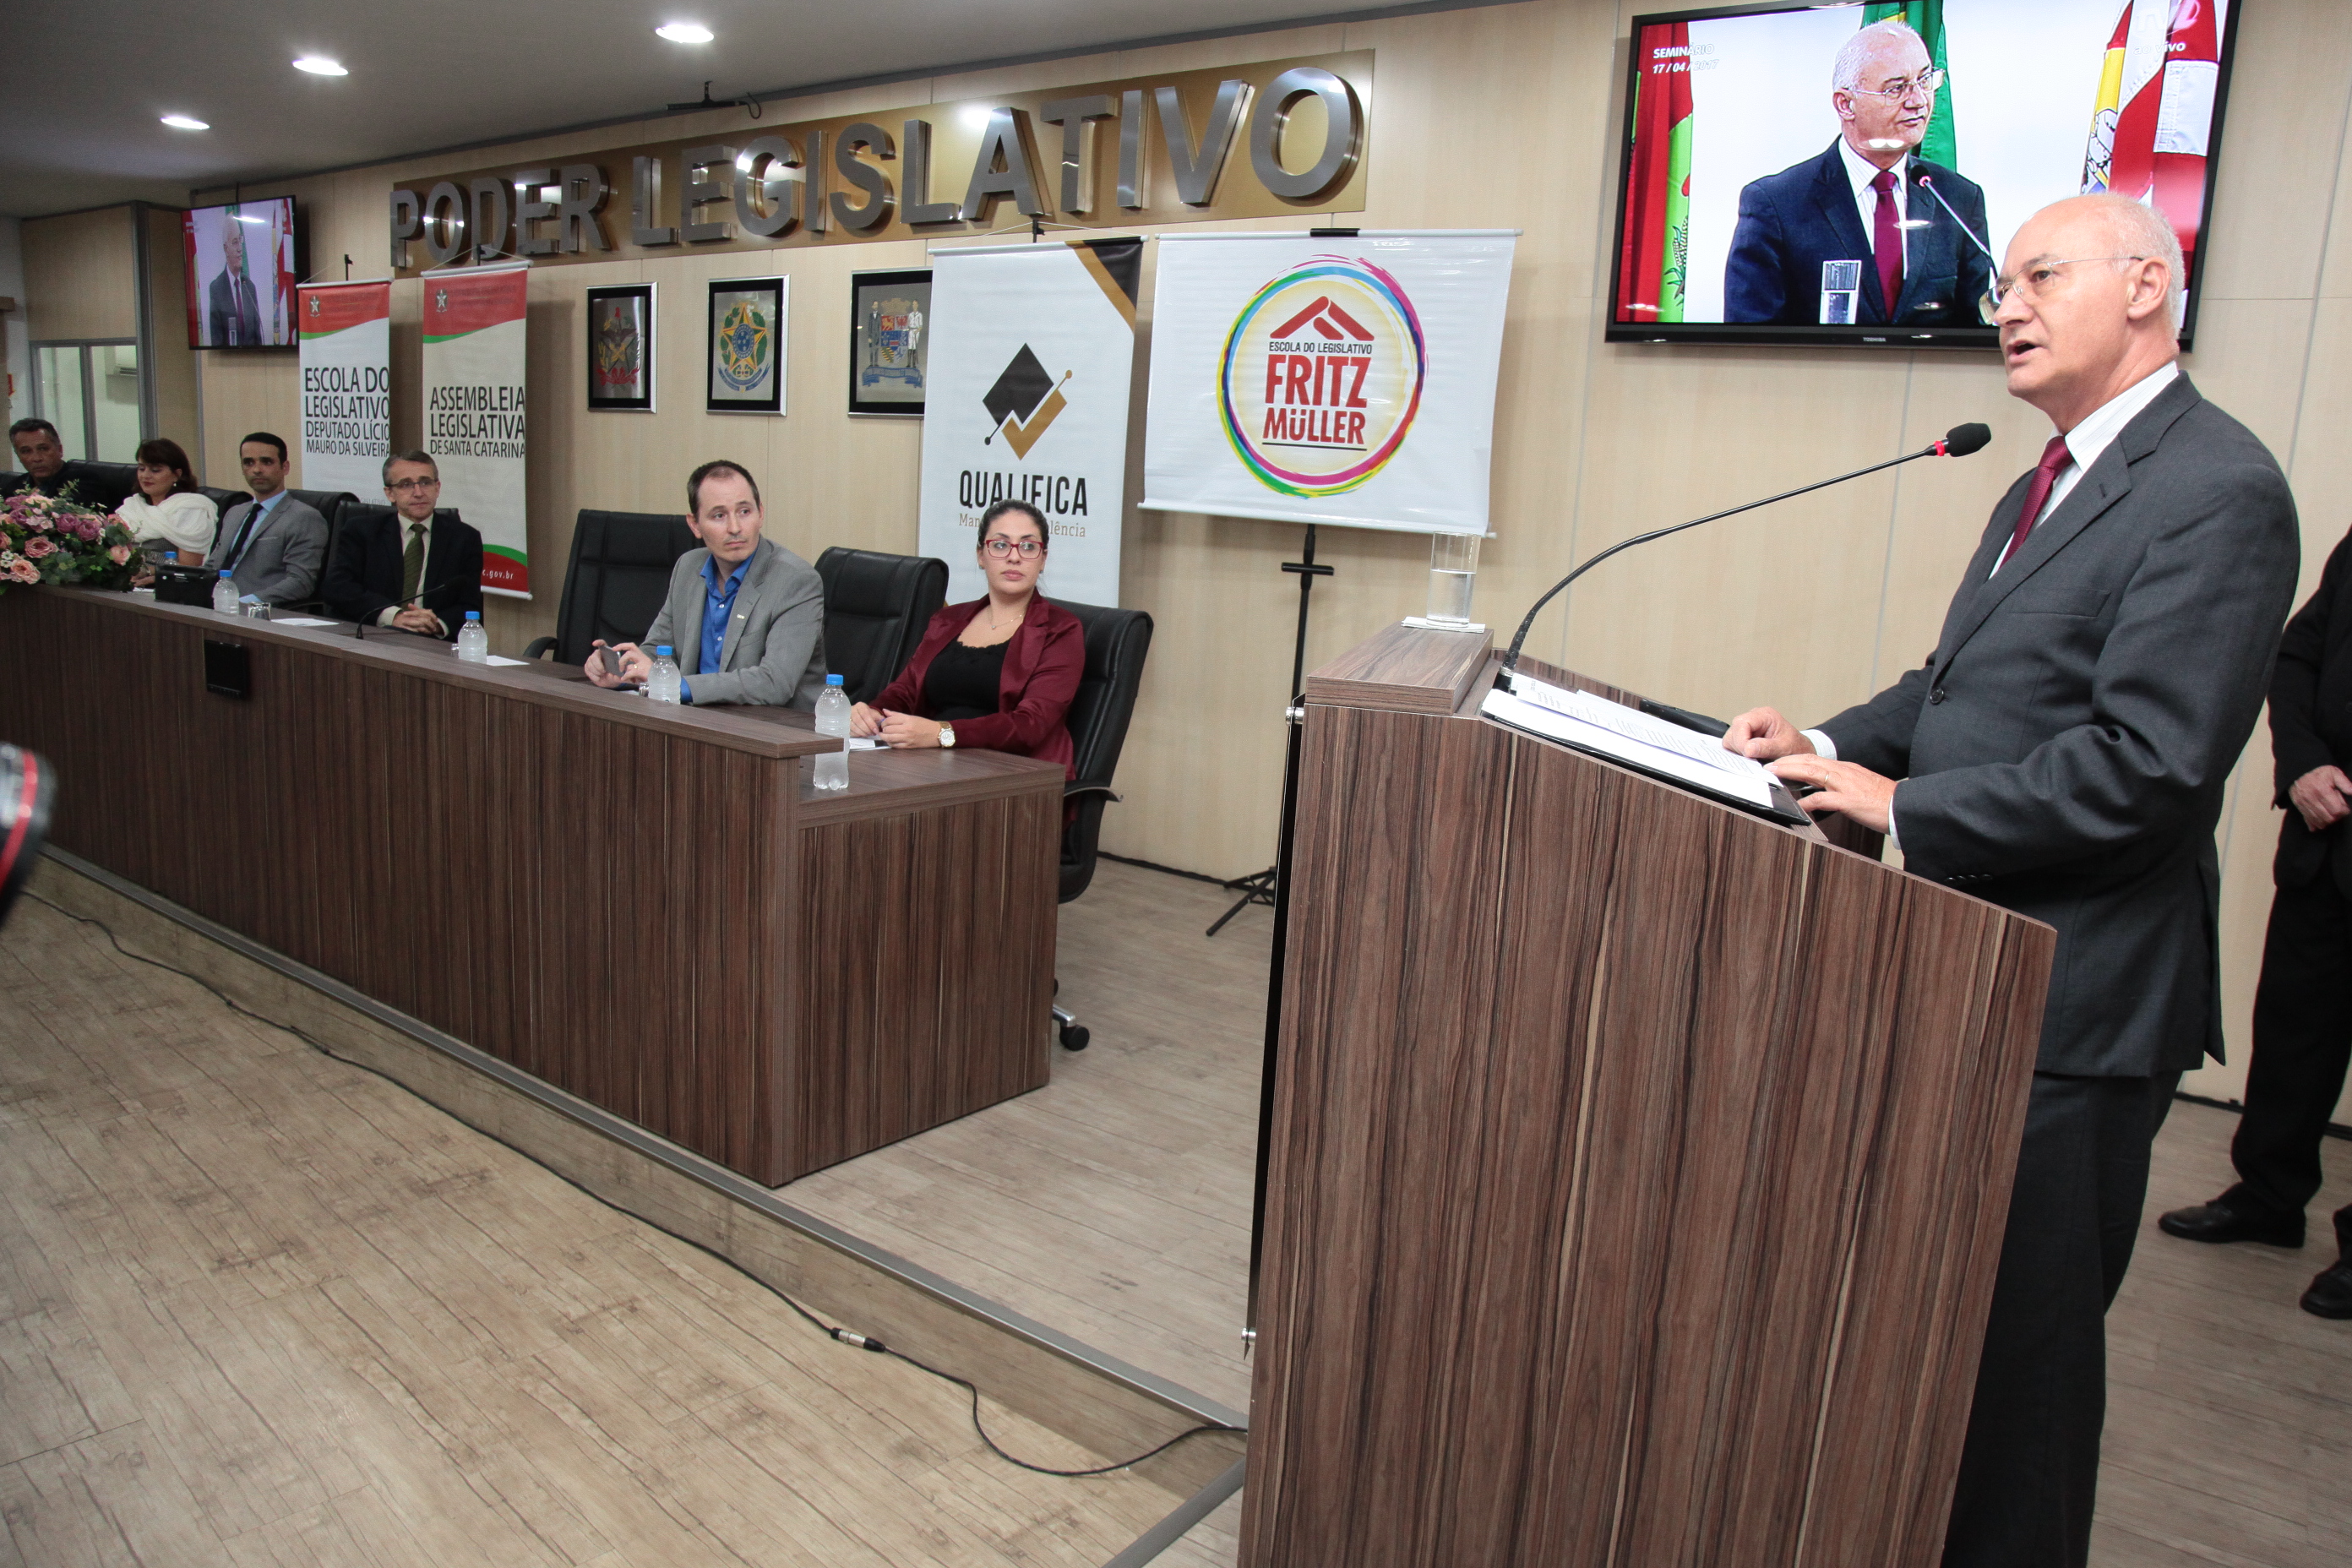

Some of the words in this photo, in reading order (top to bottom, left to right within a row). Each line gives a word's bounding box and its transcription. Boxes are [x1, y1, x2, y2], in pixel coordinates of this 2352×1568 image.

[1652, 42, 1715, 59] SEMINÁRIO
[2155, 41, 2186, 52] vivo
[389, 163, 610, 269] PODER
[632, 67, 1364, 246] LEGISLATIVO
[1269, 341, 1301, 352] ESCOLA
[1304, 342, 1315, 352] DO
[1318, 343, 1373, 354] LEGISLATIVO
[305, 367, 361, 393] ESCOLA
[365, 367, 389, 393] DO
[1265, 354, 1372, 408] FRITZ
[305, 395, 389, 420] LEGISLATIVO
[429, 386, 525, 411] ASSEMBLEIA
[306, 421, 361, 439] DEPUTADO
[363, 419, 389, 441] LÍCIO
[430, 413, 525, 439] LEGISLATIVA
[1262, 407, 1366, 444] MÜLLER
[306, 439, 337, 455] MAURO
[339, 440, 351, 455] DA
[353, 441, 390, 458] SILVEIRA
[430, 439, 443, 455] DE
[444, 439, 472, 456] SANTA
[474, 441, 525, 459] CATARINA
[959, 470, 1088, 516] QUALIFICA
